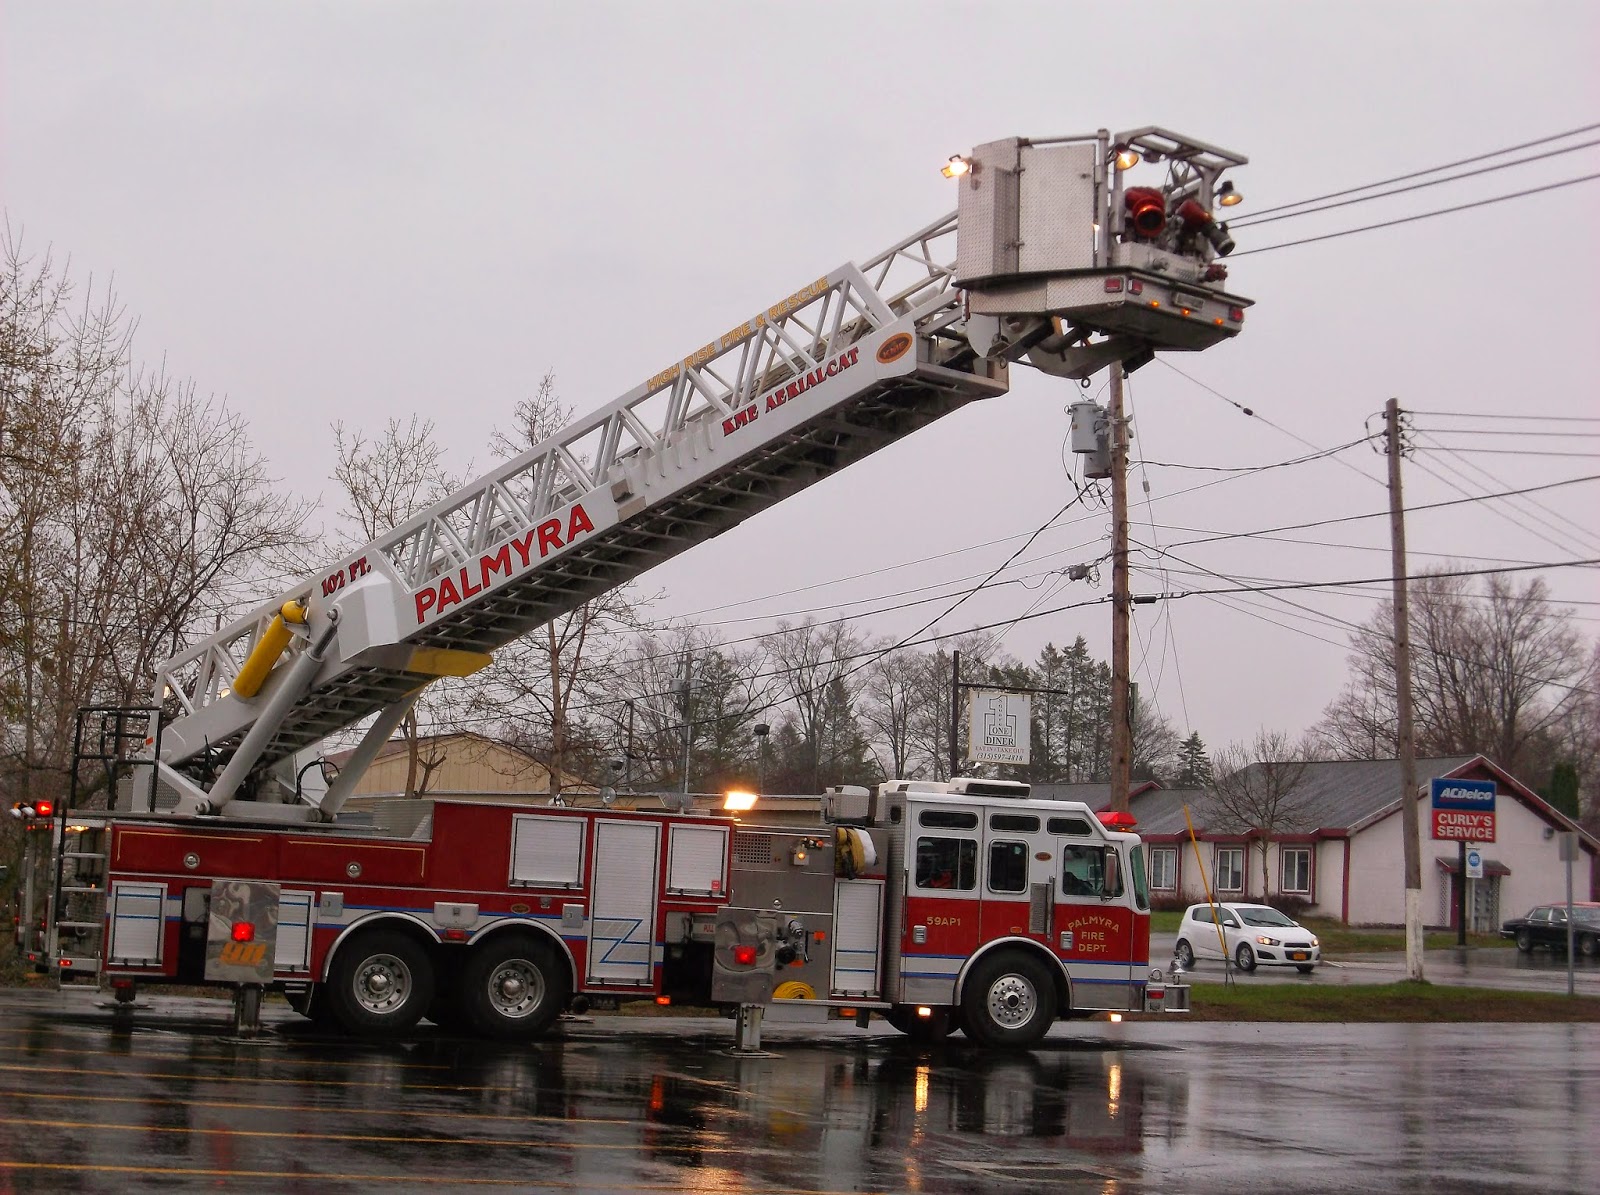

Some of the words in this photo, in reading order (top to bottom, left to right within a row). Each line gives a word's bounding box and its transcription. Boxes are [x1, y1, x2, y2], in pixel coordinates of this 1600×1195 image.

[647, 362, 680, 392] HIGH
[683, 341, 717, 371] RISE
[720, 320, 752, 349] FIRE
[755, 313, 766, 329] &
[768, 275, 830, 320] RESCUE
[721, 403, 759, 437] KME
[414, 503, 596, 625] PALMYRA
[321, 569, 346, 598] 102
[348, 555, 372, 583] FT.
[992, 726, 1009, 735] ONE
[986, 736, 1014, 746] DINER
[1440, 787, 1493, 801] ACDelco
[1437, 813, 1493, 827] CURLY'S
[1437, 825, 1493, 839] SERVICE
[926, 916, 961, 926] 59AP1
[1067, 916, 1120, 933] PALMYRA
[1081, 931, 1105, 940] FIRE
